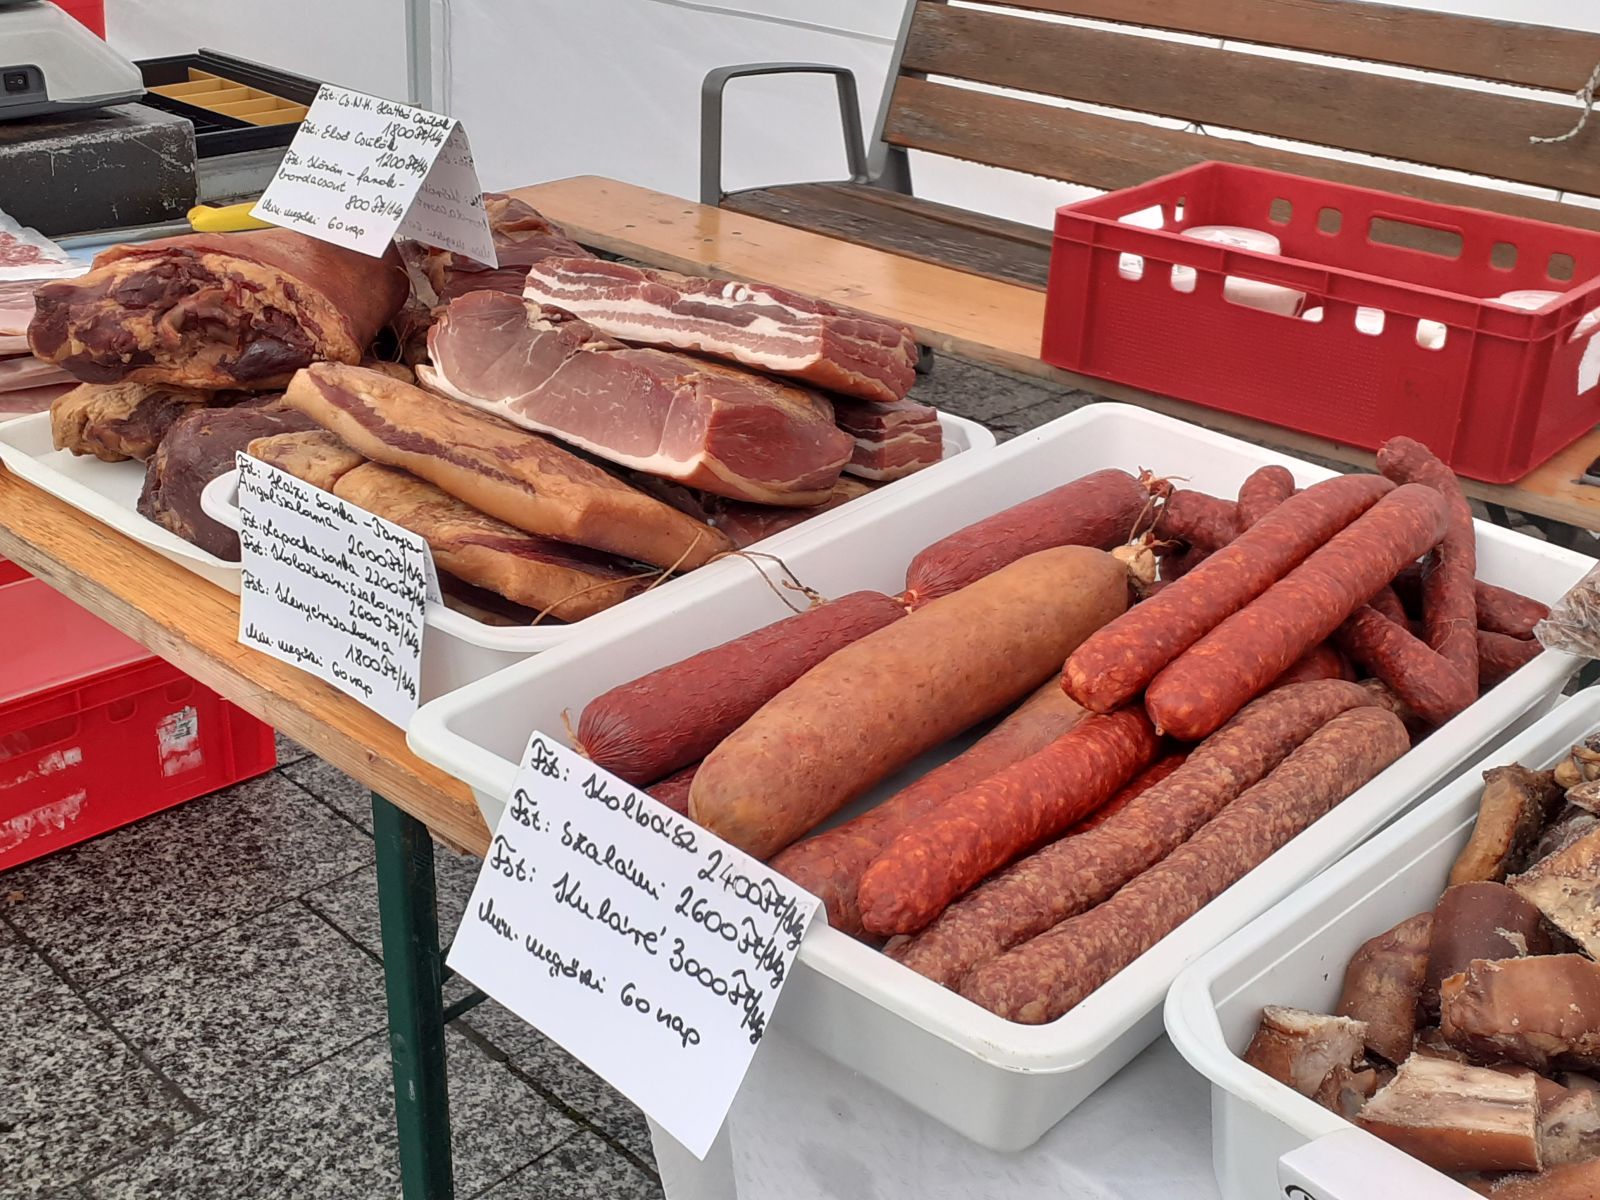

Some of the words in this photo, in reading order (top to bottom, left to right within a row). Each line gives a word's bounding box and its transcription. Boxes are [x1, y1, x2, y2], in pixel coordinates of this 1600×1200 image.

[582, 774, 698, 854] Kolbász
[620, 983, 650, 1014] 60
[657, 1010, 700, 1049] nap
